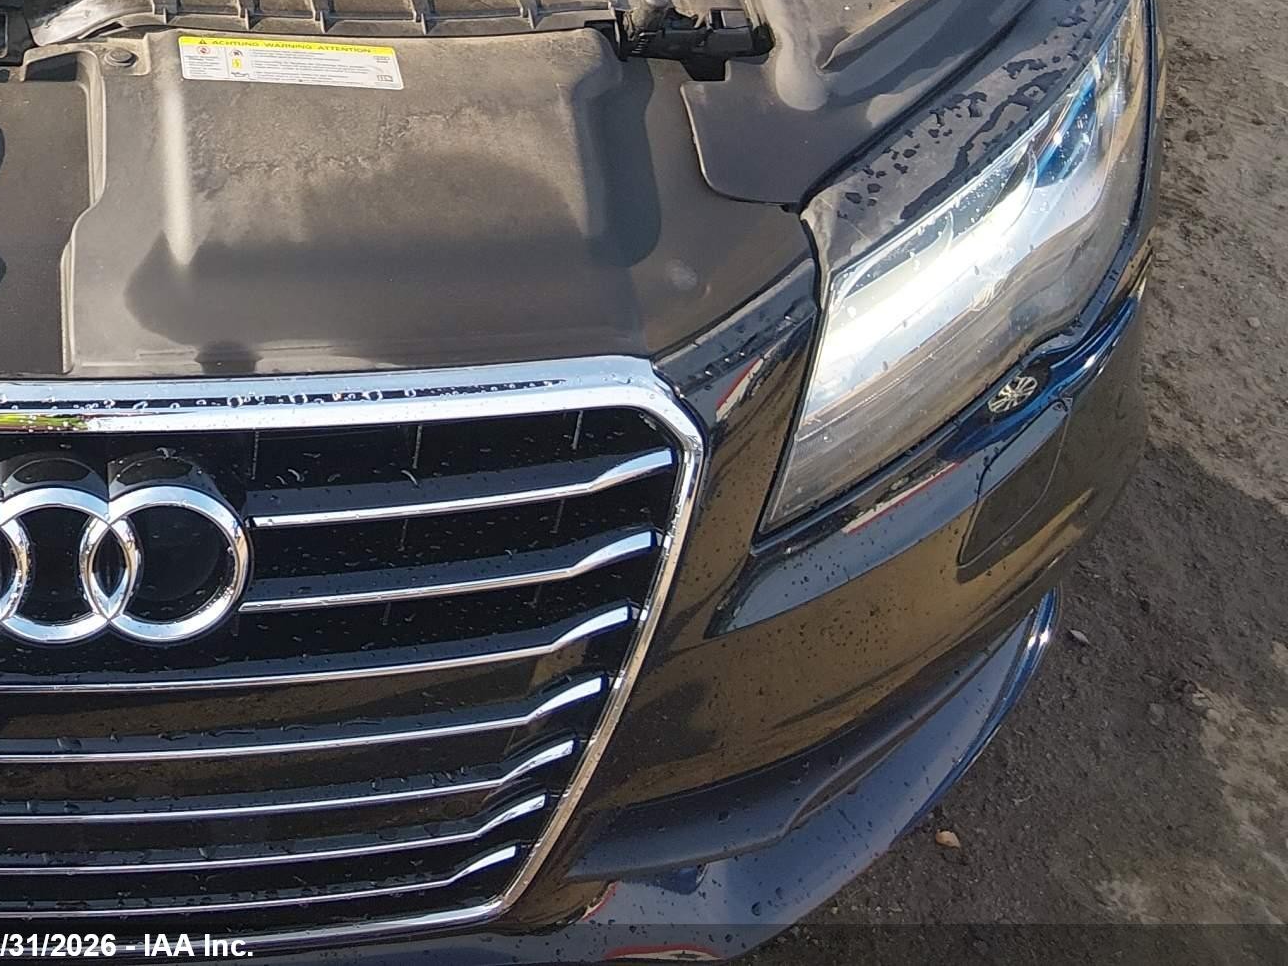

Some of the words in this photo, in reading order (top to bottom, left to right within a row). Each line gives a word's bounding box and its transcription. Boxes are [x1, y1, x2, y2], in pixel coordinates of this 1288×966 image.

[212, 39, 259, 47] ACHTUNG
[264, 42, 312, 50] WARNING
[317, 45, 371, 53] ATTENTION
